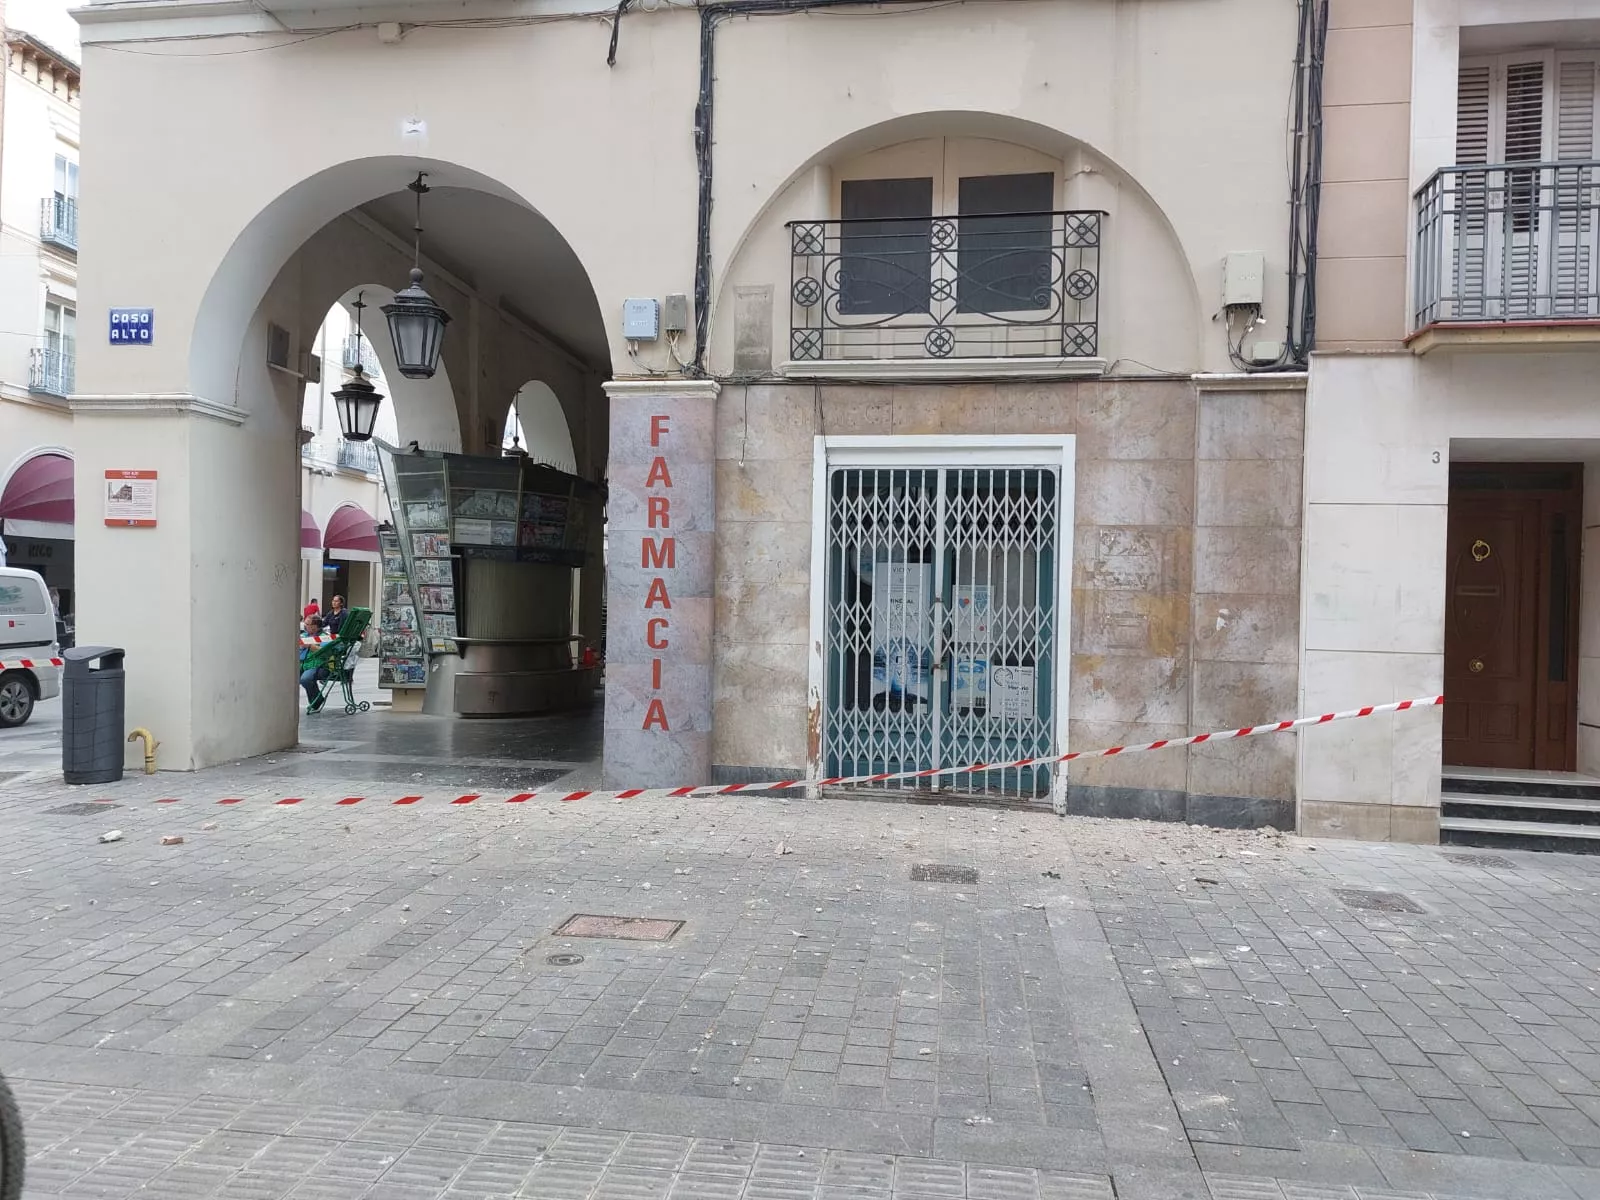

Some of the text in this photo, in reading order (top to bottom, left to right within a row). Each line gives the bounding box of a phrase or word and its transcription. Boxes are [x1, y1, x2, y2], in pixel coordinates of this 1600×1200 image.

[112, 313, 149, 323] COSO
[112, 329, 149, 339] ALTO
[1431, 450, 1441, 464] 3
[641, 415, 676, 731] FARMACIA
